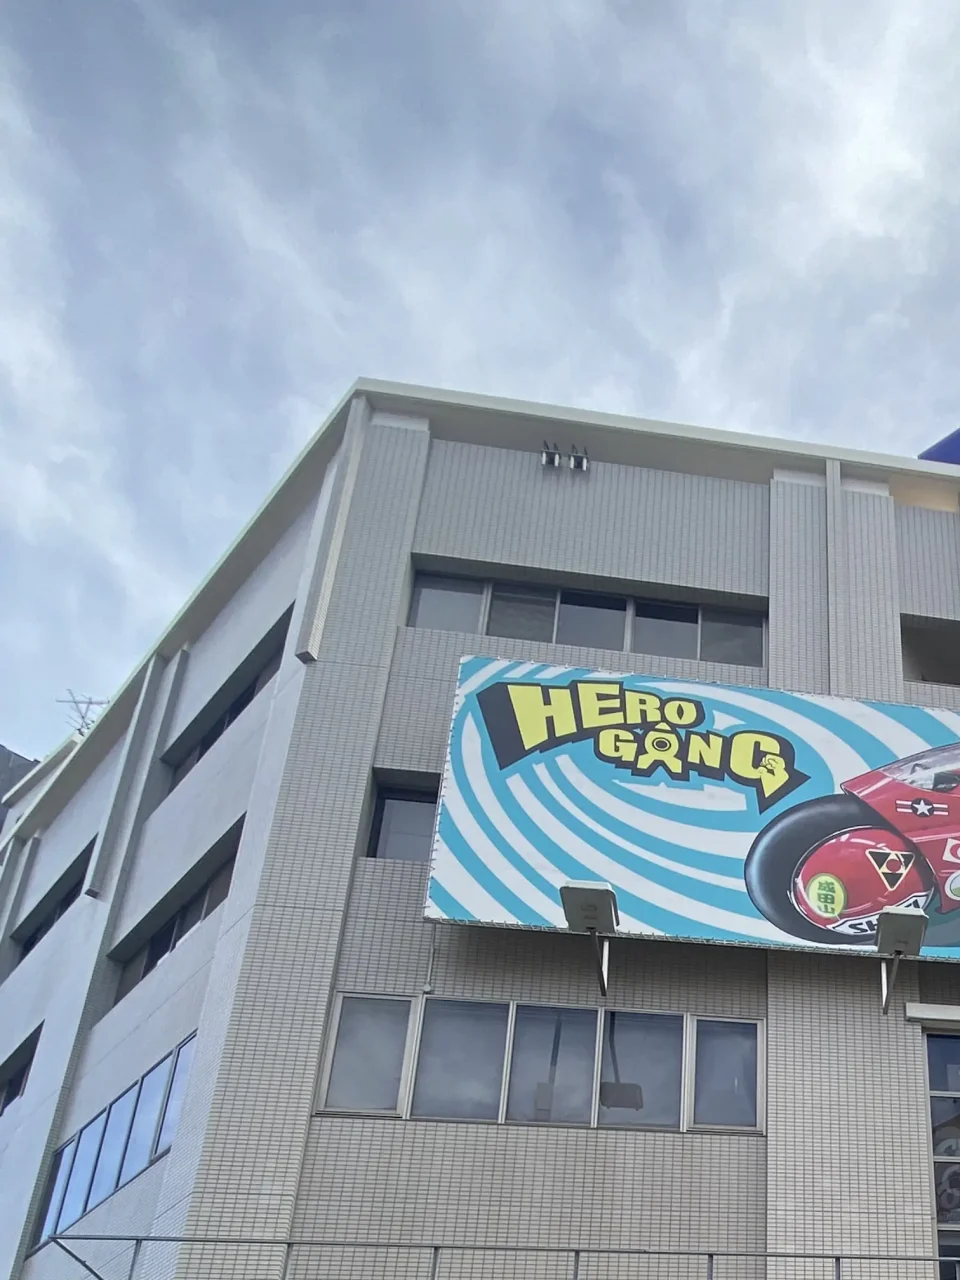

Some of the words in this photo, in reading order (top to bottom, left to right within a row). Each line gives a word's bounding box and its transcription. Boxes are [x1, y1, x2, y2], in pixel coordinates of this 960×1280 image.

[504, 681, 699, 752] HERO
[597, 721, 791, 800] GANG
[816, 880, 837, 915] 成田山
